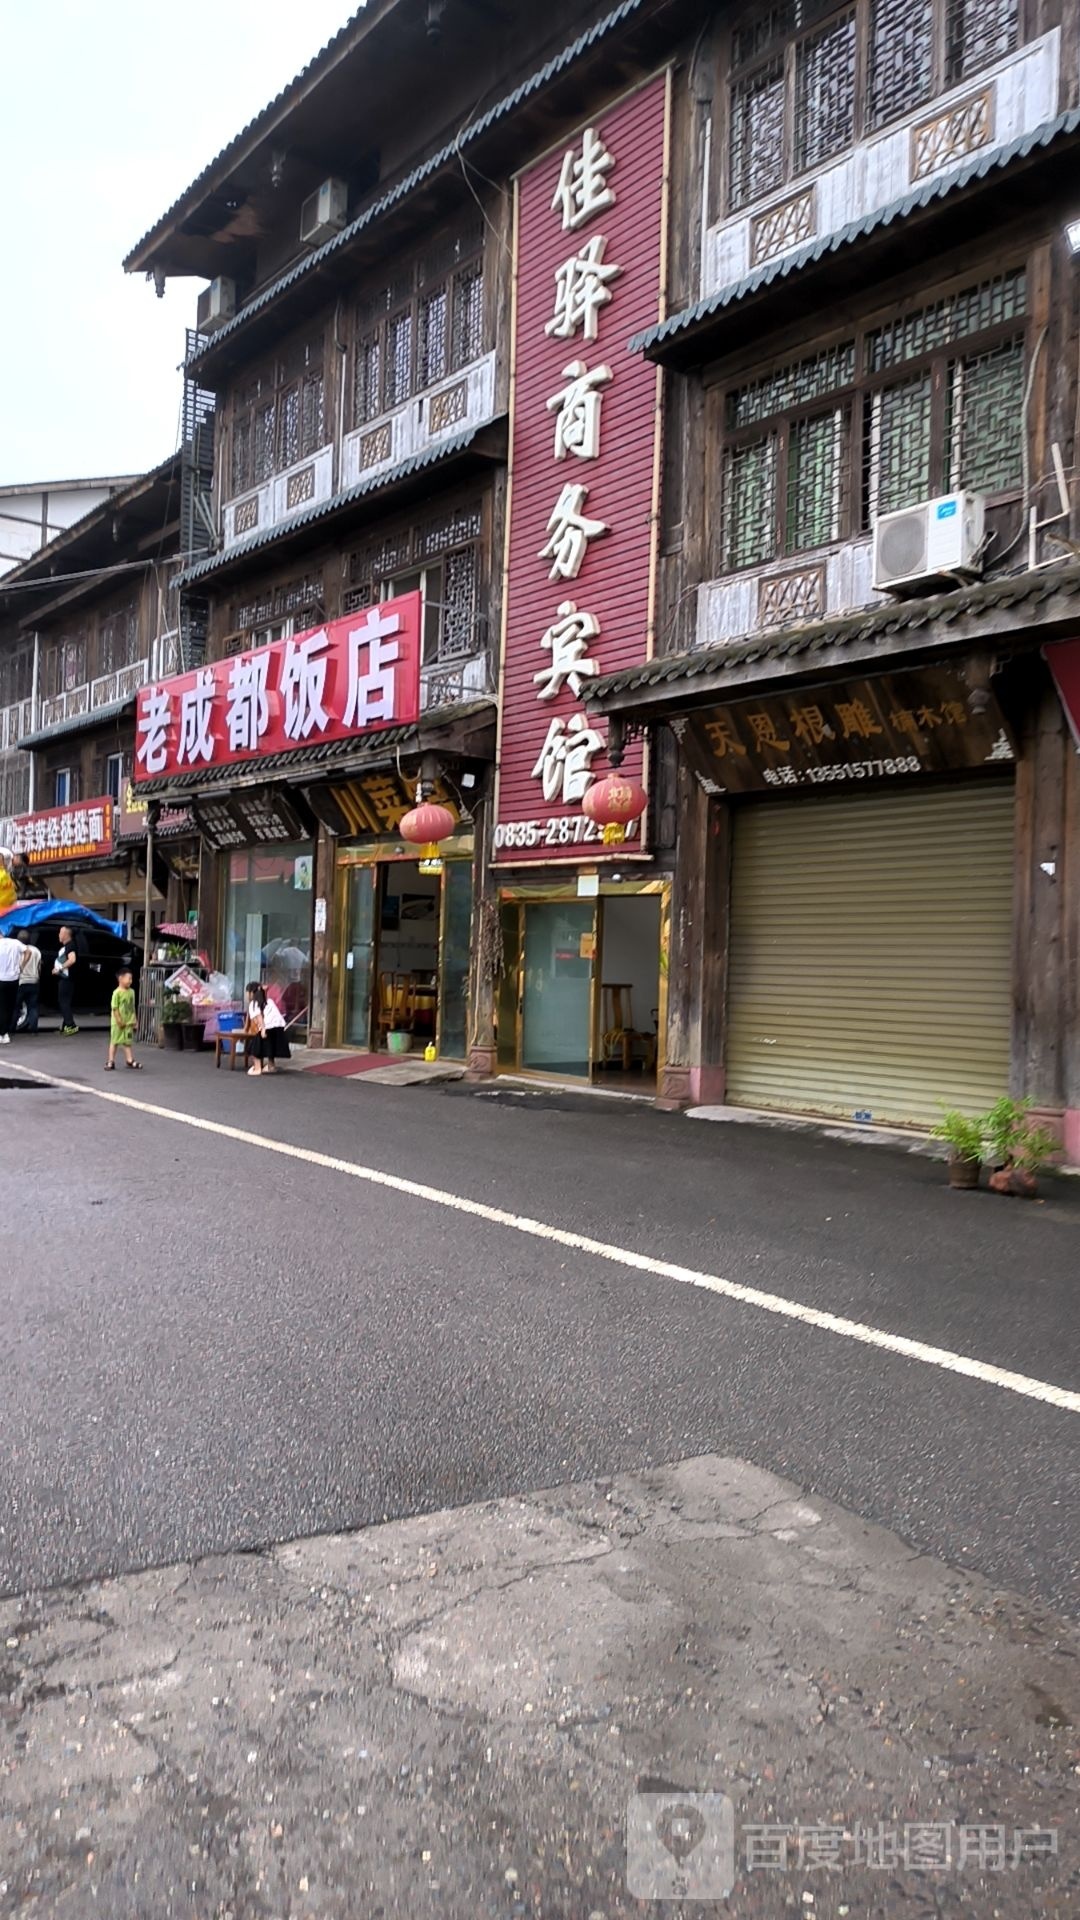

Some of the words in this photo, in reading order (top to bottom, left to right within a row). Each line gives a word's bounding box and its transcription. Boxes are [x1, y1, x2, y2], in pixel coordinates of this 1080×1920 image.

[532, 126, 623, 805] 佳驿商务宾馆
[137, 608, 401, 774] 老成都饭店
[704, 697, 883, 757] 天恩根雕
